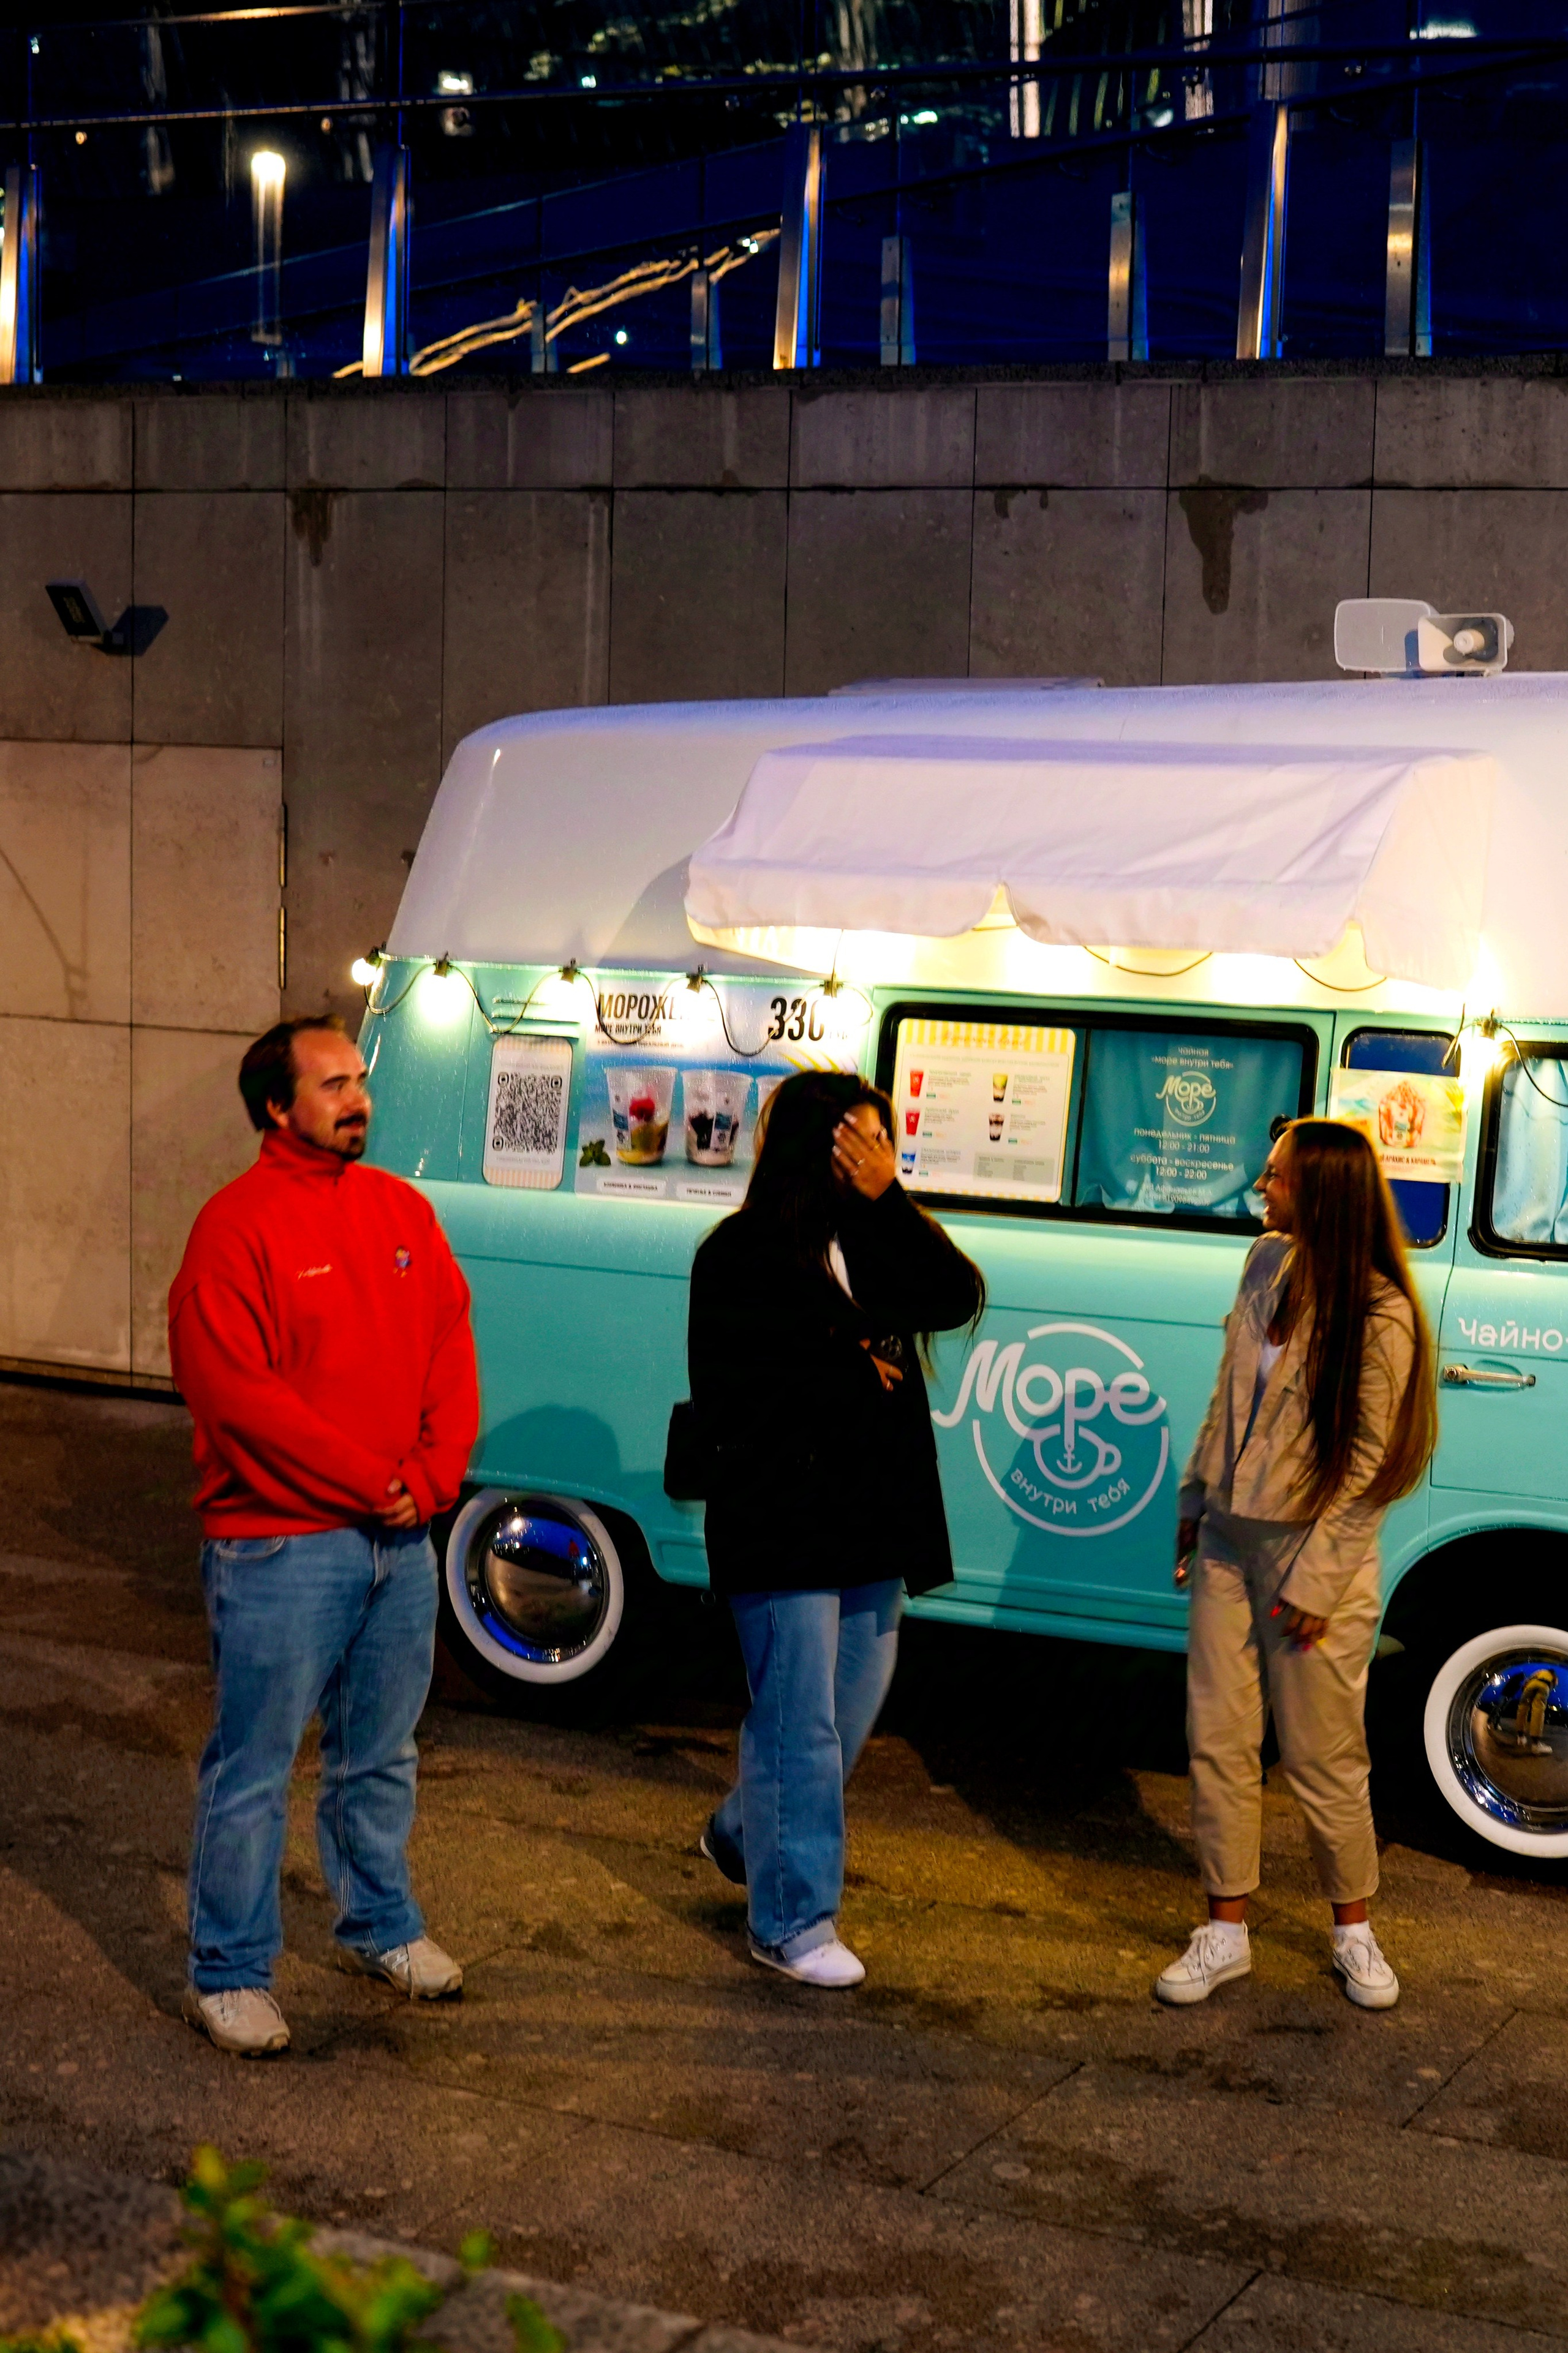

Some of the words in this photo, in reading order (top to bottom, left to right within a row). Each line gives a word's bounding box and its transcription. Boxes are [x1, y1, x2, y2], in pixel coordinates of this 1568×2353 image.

[595, 1024, 612, 1034] МРЕ
[598, 993, 717, 1022] МОРОЖЕ
[767, 996, 827, 1041] 330
[930, 1339, 1167, 1450] Море
[1009, 1467, 1077, 1515] внутри
[1087, 1477, 1131, 1513] тебя
